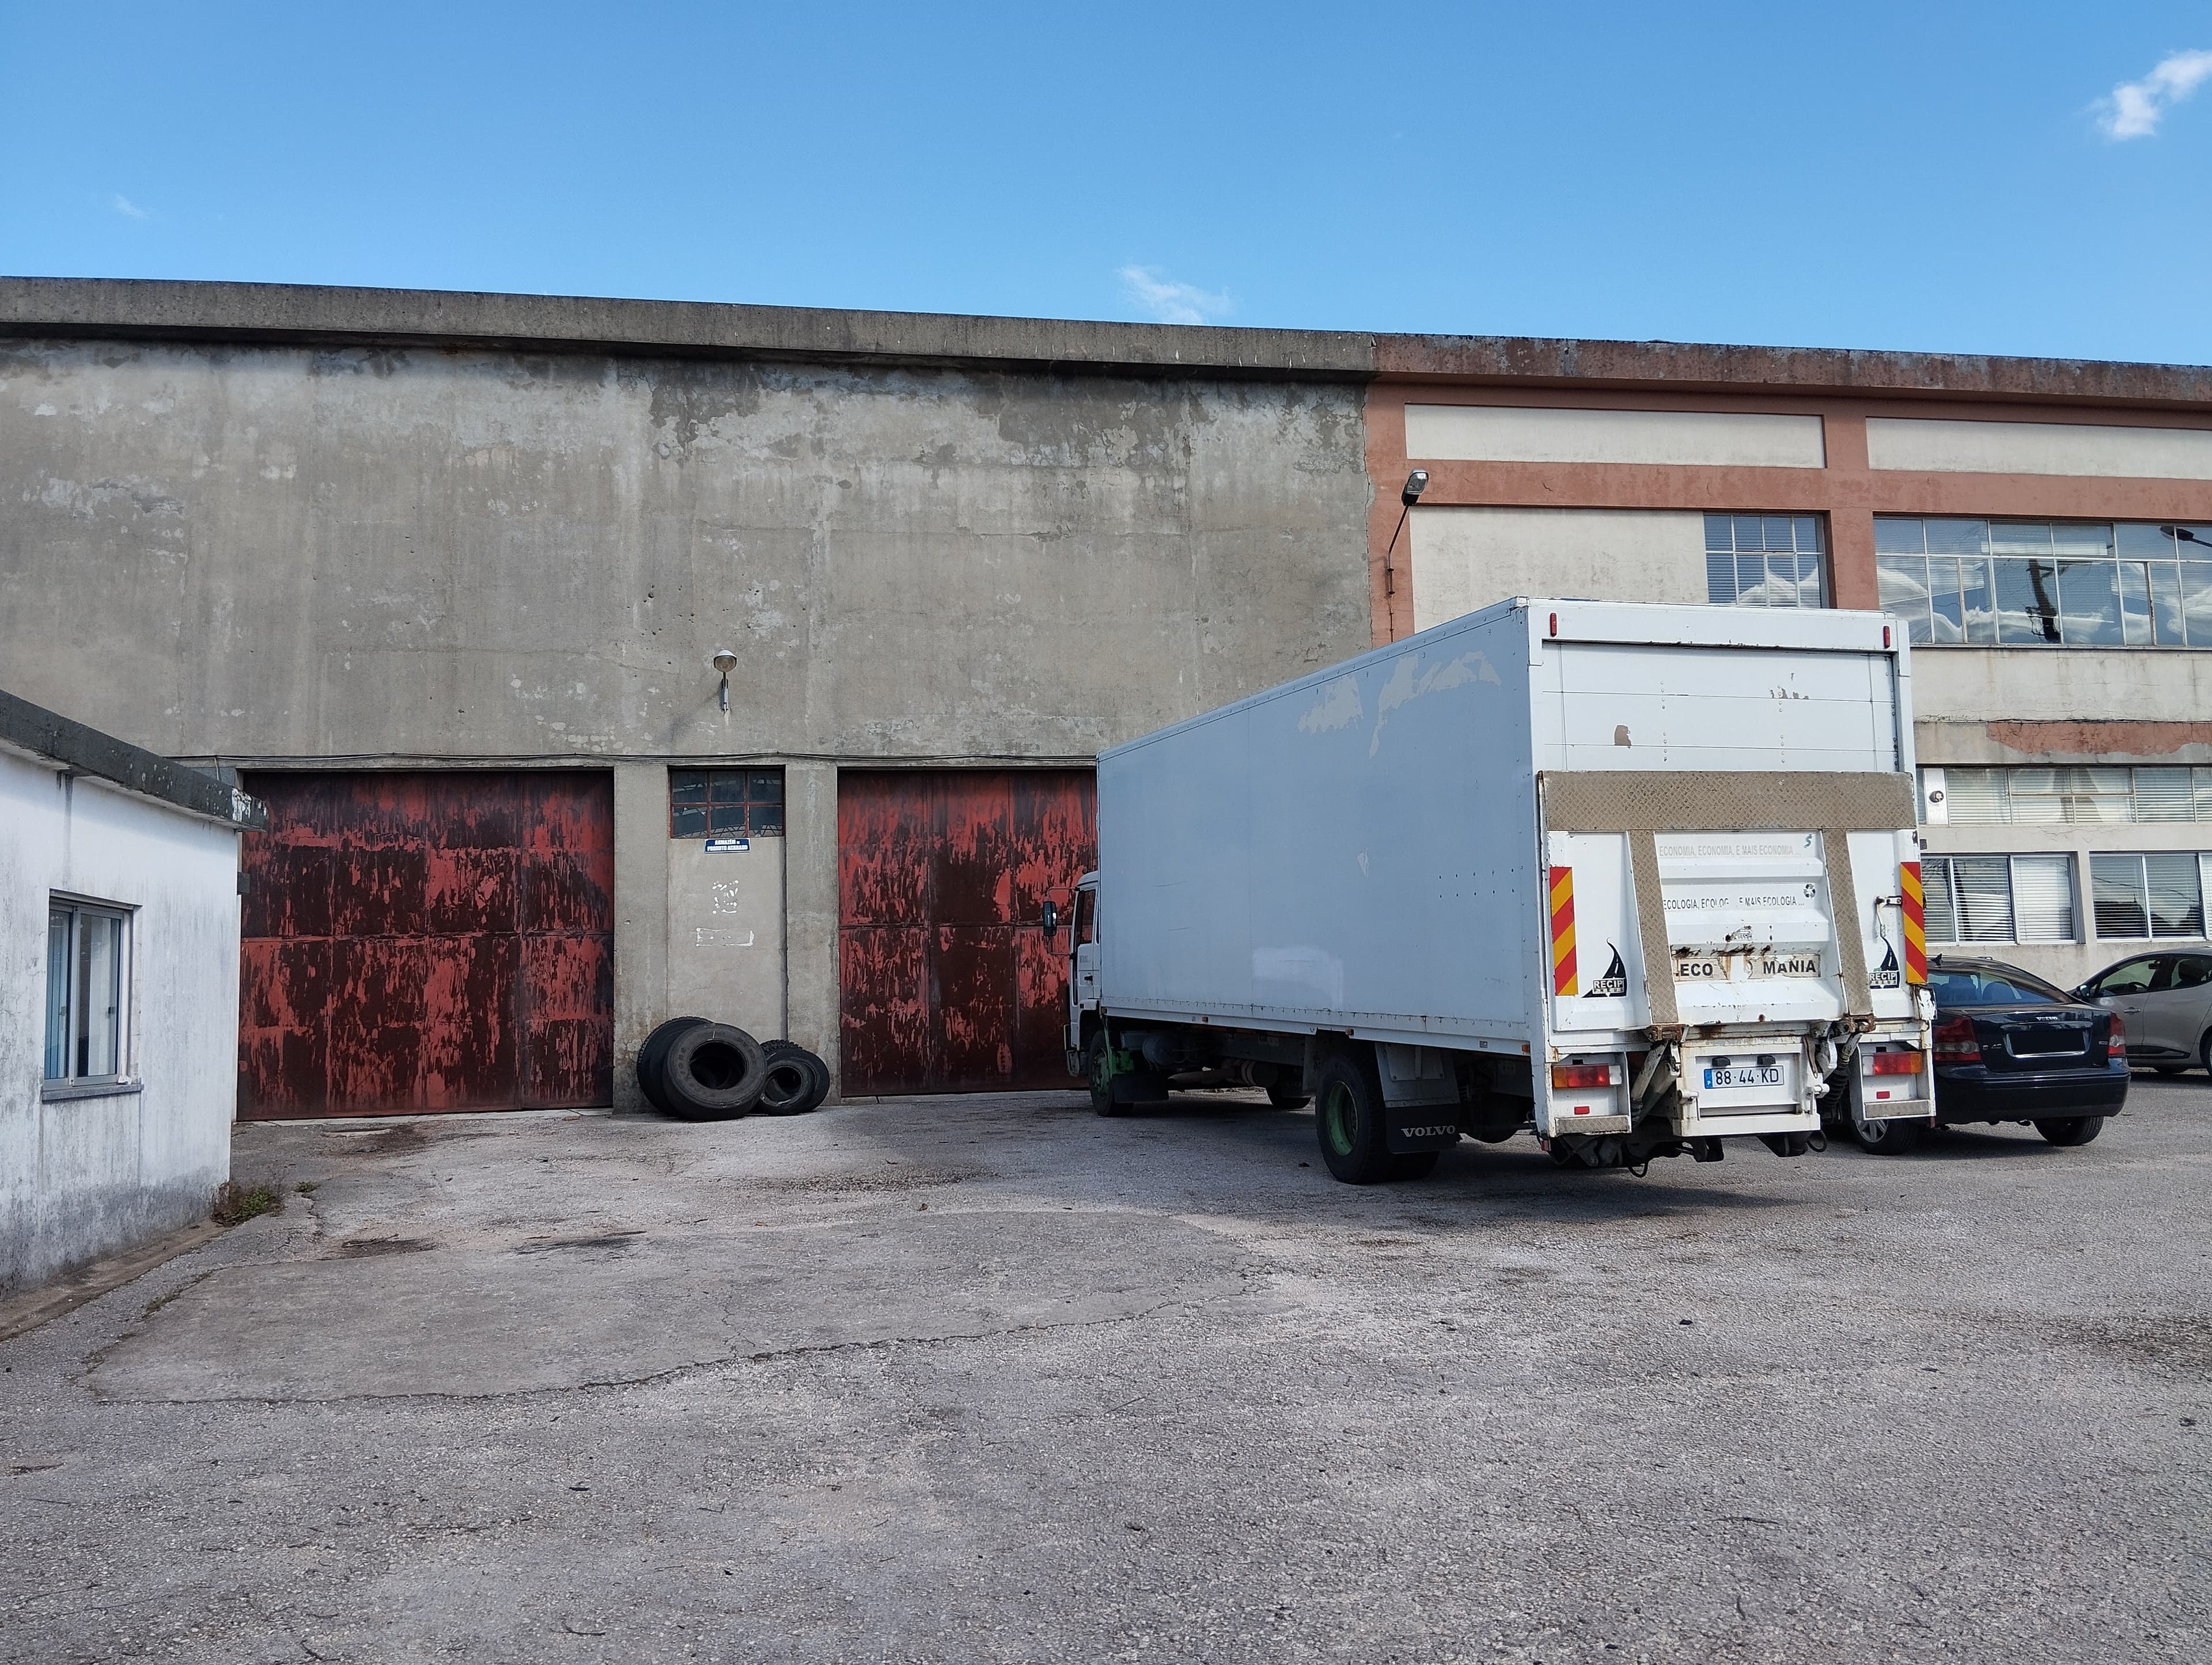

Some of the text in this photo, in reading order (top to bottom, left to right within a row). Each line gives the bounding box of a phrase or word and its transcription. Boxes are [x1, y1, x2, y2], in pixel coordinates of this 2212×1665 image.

[1698, 845, 1734, 857] ECONOMIA,
[1736, 845, 1740, 855] E
[1742, 845, 1757, 855] MAIS
[1763, 959, 1816, 974] MANIA
[1869, 972, 1896, 981] RECIP
[1593, 980, 1623, 988] RECIP
[1401, 1125, 1456, 1137] VOLVO
